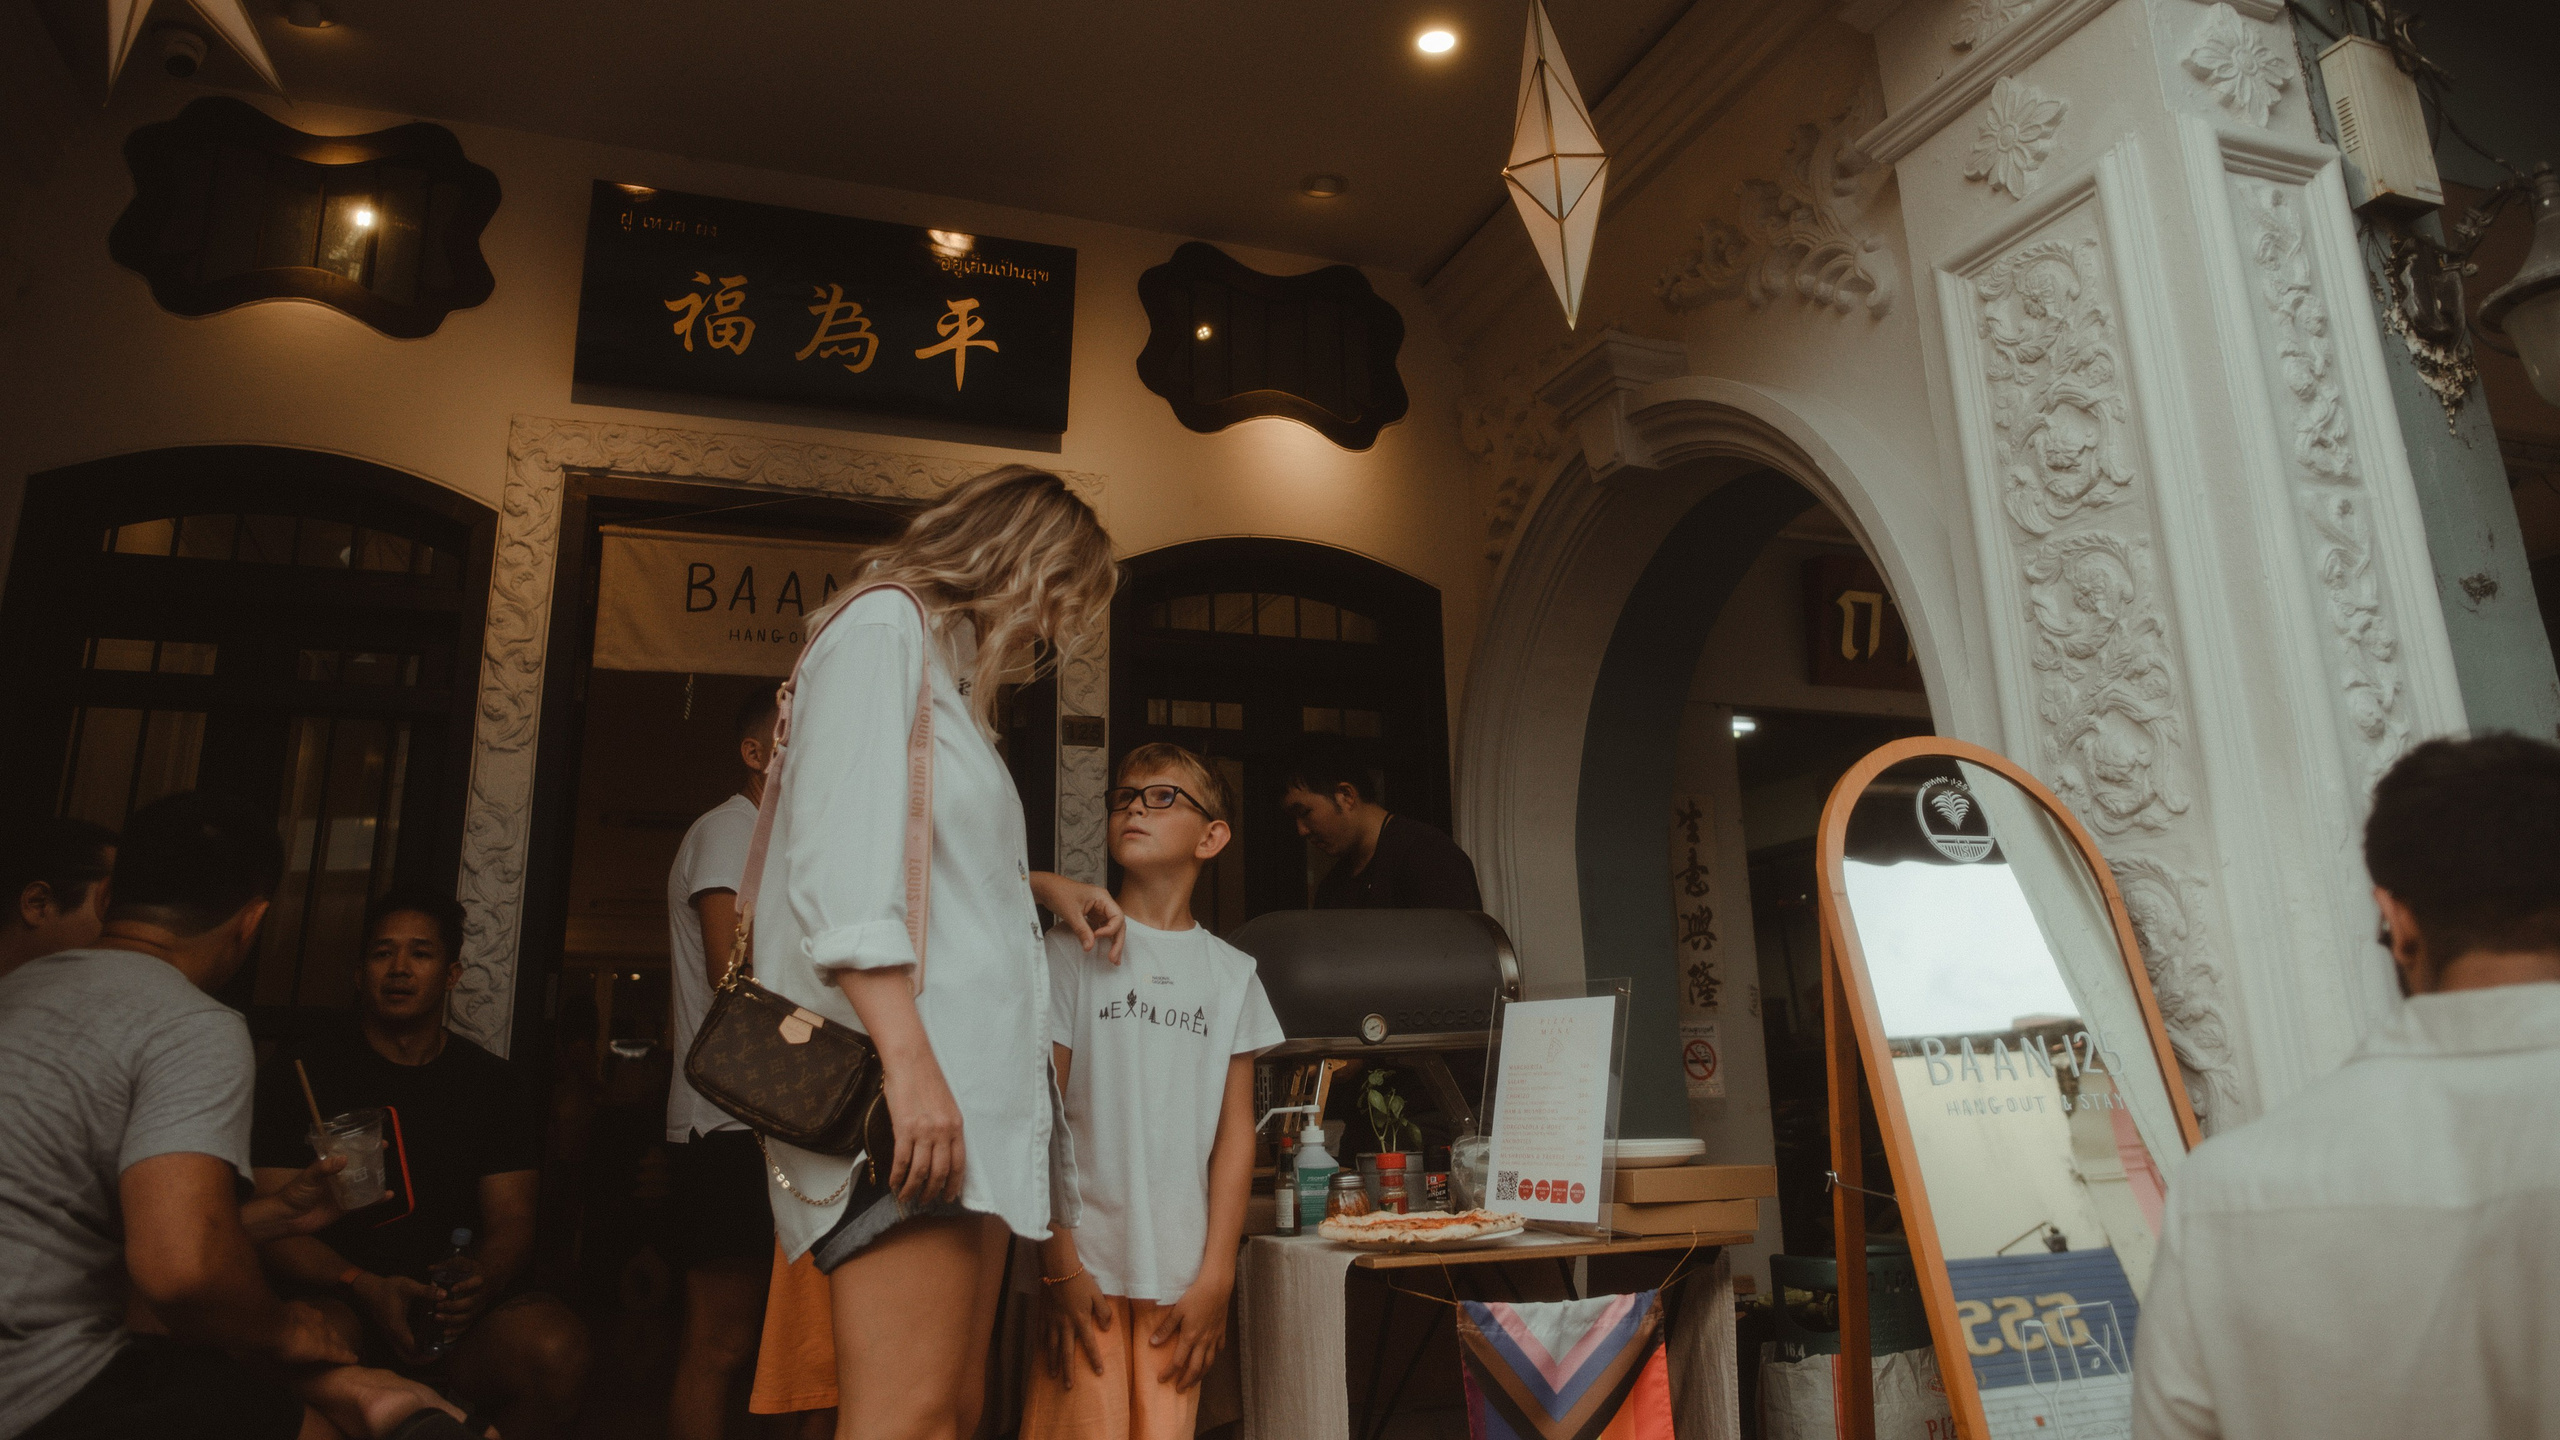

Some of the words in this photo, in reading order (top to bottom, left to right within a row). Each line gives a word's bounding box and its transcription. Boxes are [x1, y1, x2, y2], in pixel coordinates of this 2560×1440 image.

[914, 705, 931, 748] LOUIS
[911, 756, 926, 818] VUITTON
[1110, 998, 1205, 1034] EXPLORE
[1919, 1036, 2053, 1086] BAAN
[2062, 1031, 2124, 1078] 125
[2061, 1094, 2072, 1111] &
[2081, 1093, 2126, 1111] STAY
